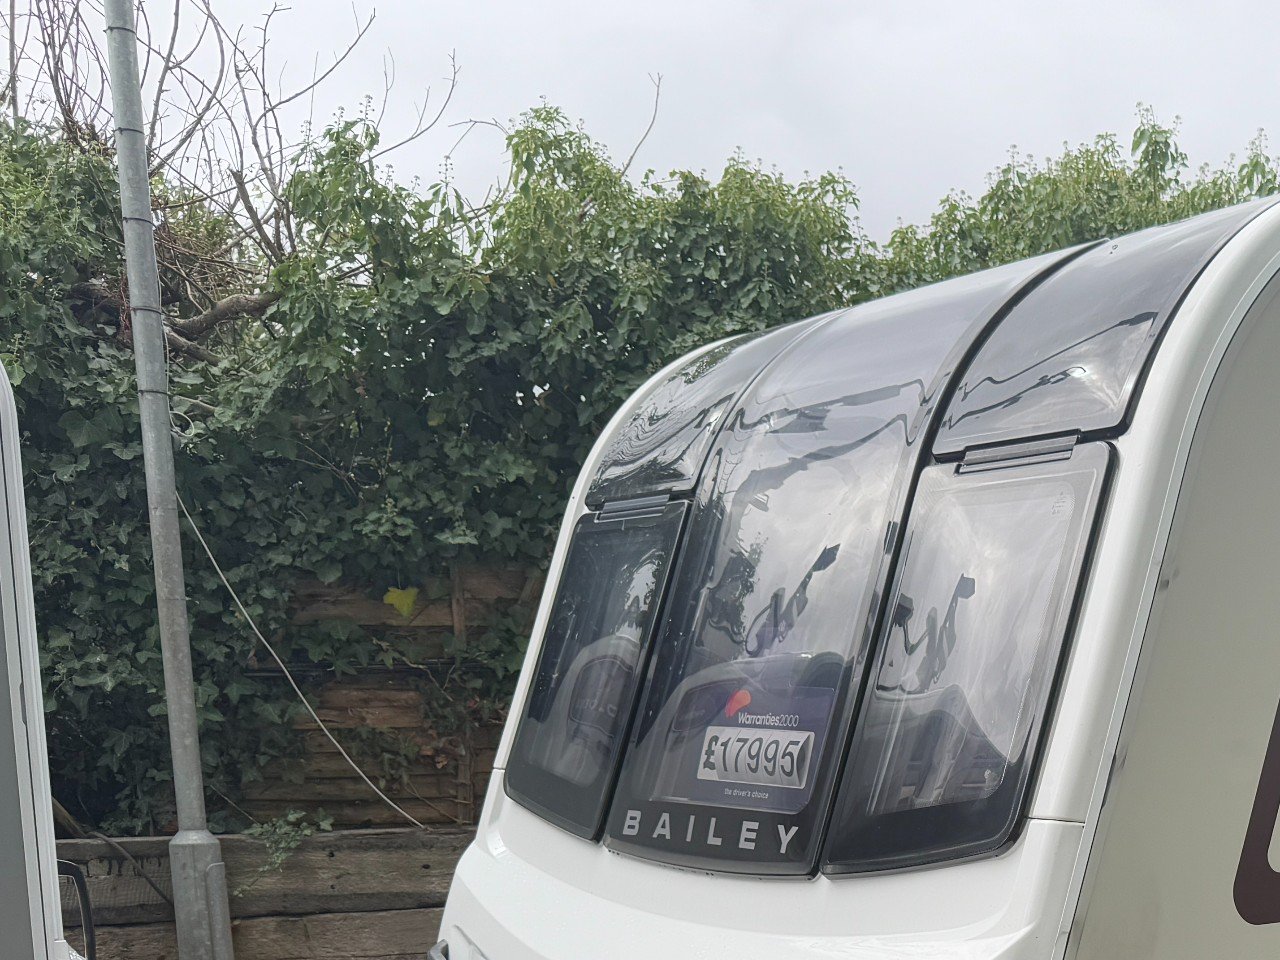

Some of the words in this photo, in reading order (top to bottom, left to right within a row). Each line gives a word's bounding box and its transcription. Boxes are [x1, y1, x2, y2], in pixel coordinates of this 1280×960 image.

[738, 712, 799, 727] Warranties2000
[703, 735, 801, 777] £17995
[622, 810, 799, 854] BAILEY
